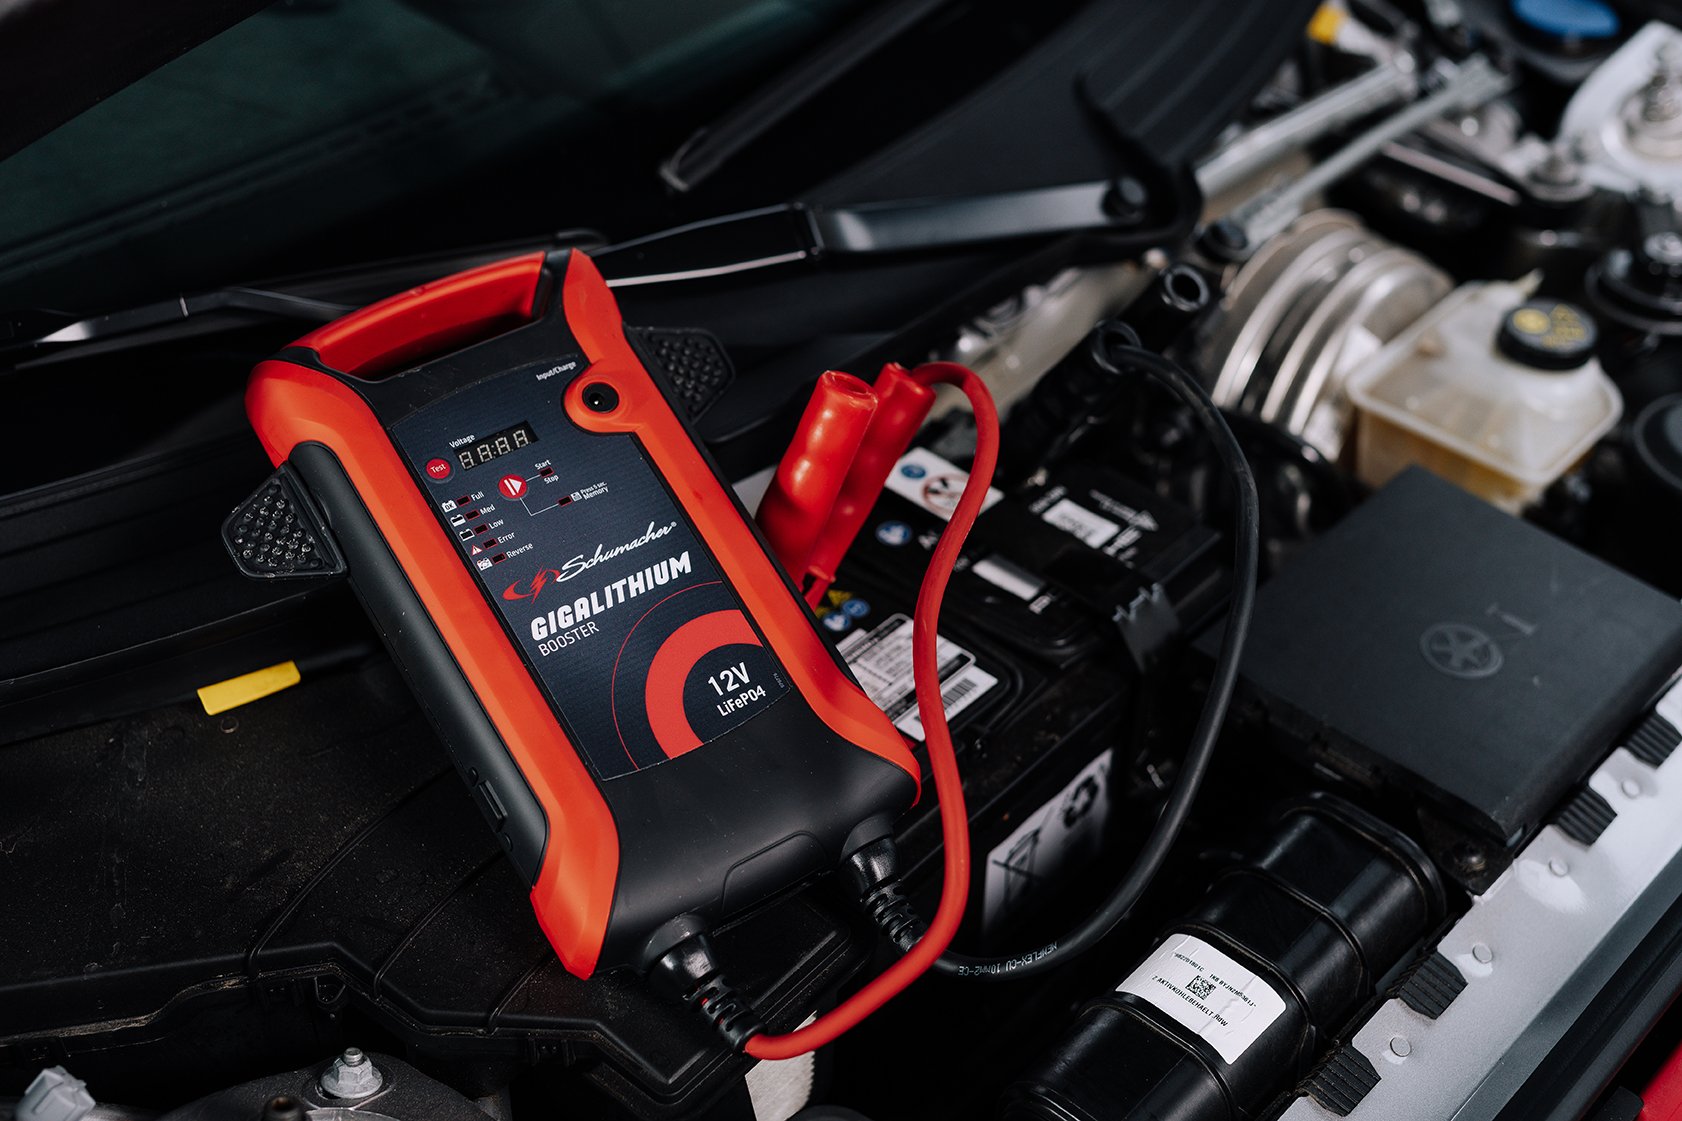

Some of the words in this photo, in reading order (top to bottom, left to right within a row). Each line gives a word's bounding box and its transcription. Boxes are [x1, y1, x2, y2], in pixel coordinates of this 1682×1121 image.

[536, 361, 577, 381] Input/Charge
[449, 433, 475, 449] Voltage
[430, 463, 447, 473] Test
[534, 459, 551, 470] Start
[543, 473, 560, 485] Stop
[471, 491, 485, 501] Full
[582, 486, 609, 500] Memory
[480, 504, 496, 515] Med
[488, 518, 504, 530] Low
[497, 531, 516, 544] Error
[506, 542, 534, 559] Reverse
[530, 550, 693, 641] GIGALITHIUM
[537, 621, 600, 657] BOOSTER
[707, 662, 752, 697] 12V
